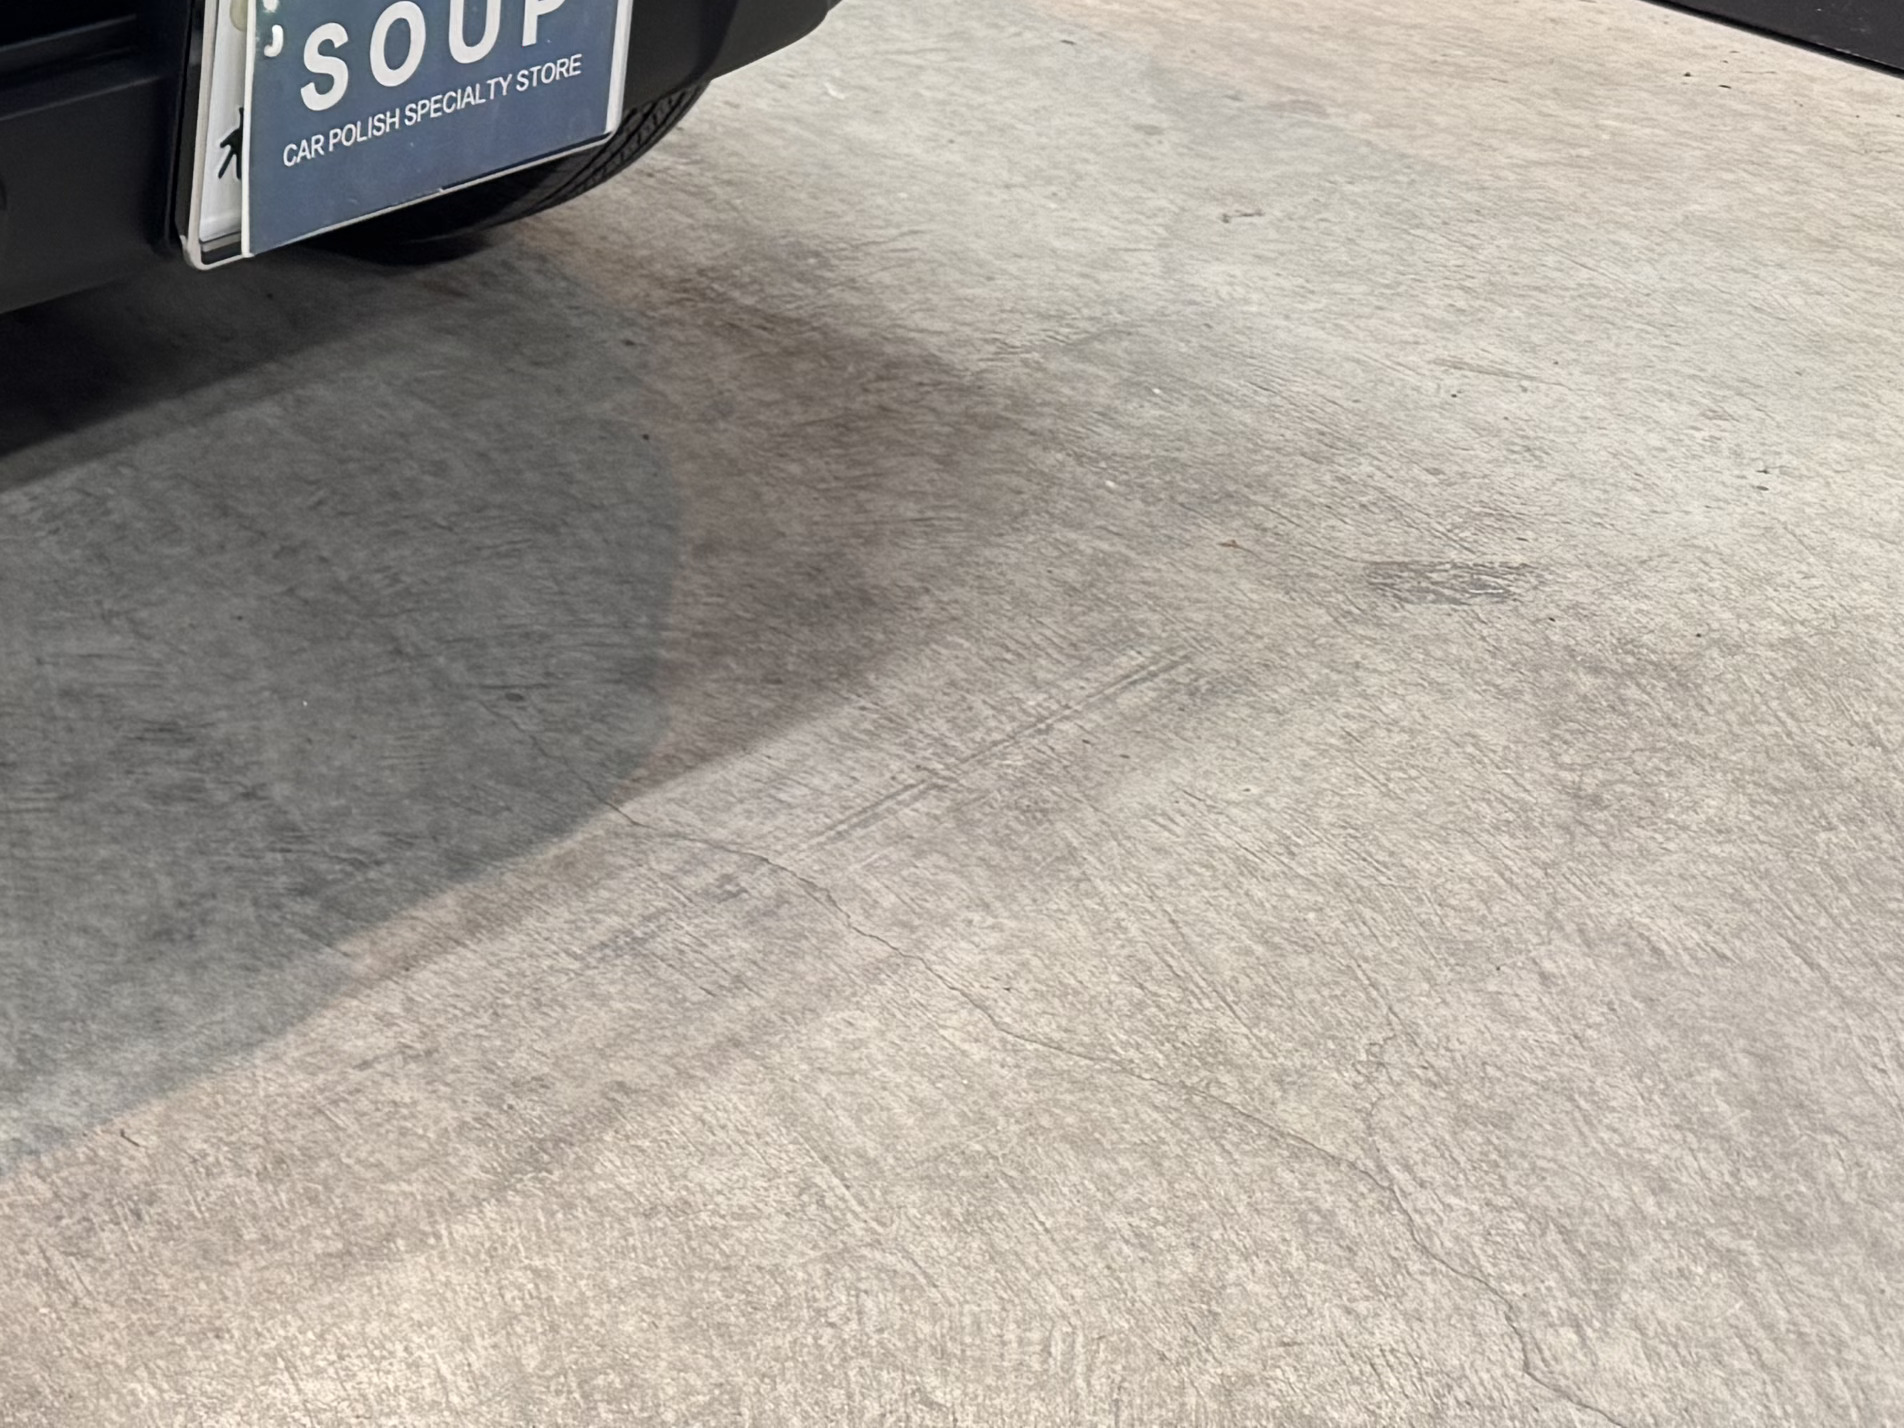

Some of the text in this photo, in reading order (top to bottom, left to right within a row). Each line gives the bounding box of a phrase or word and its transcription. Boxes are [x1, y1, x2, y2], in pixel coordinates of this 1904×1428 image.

[282, 134, 325, 168] CAR
[328, 107, 401, 152] POLISH
[403, 73, 513, 127] SPECIALTY
[515, 52, 584, 93] STORE
